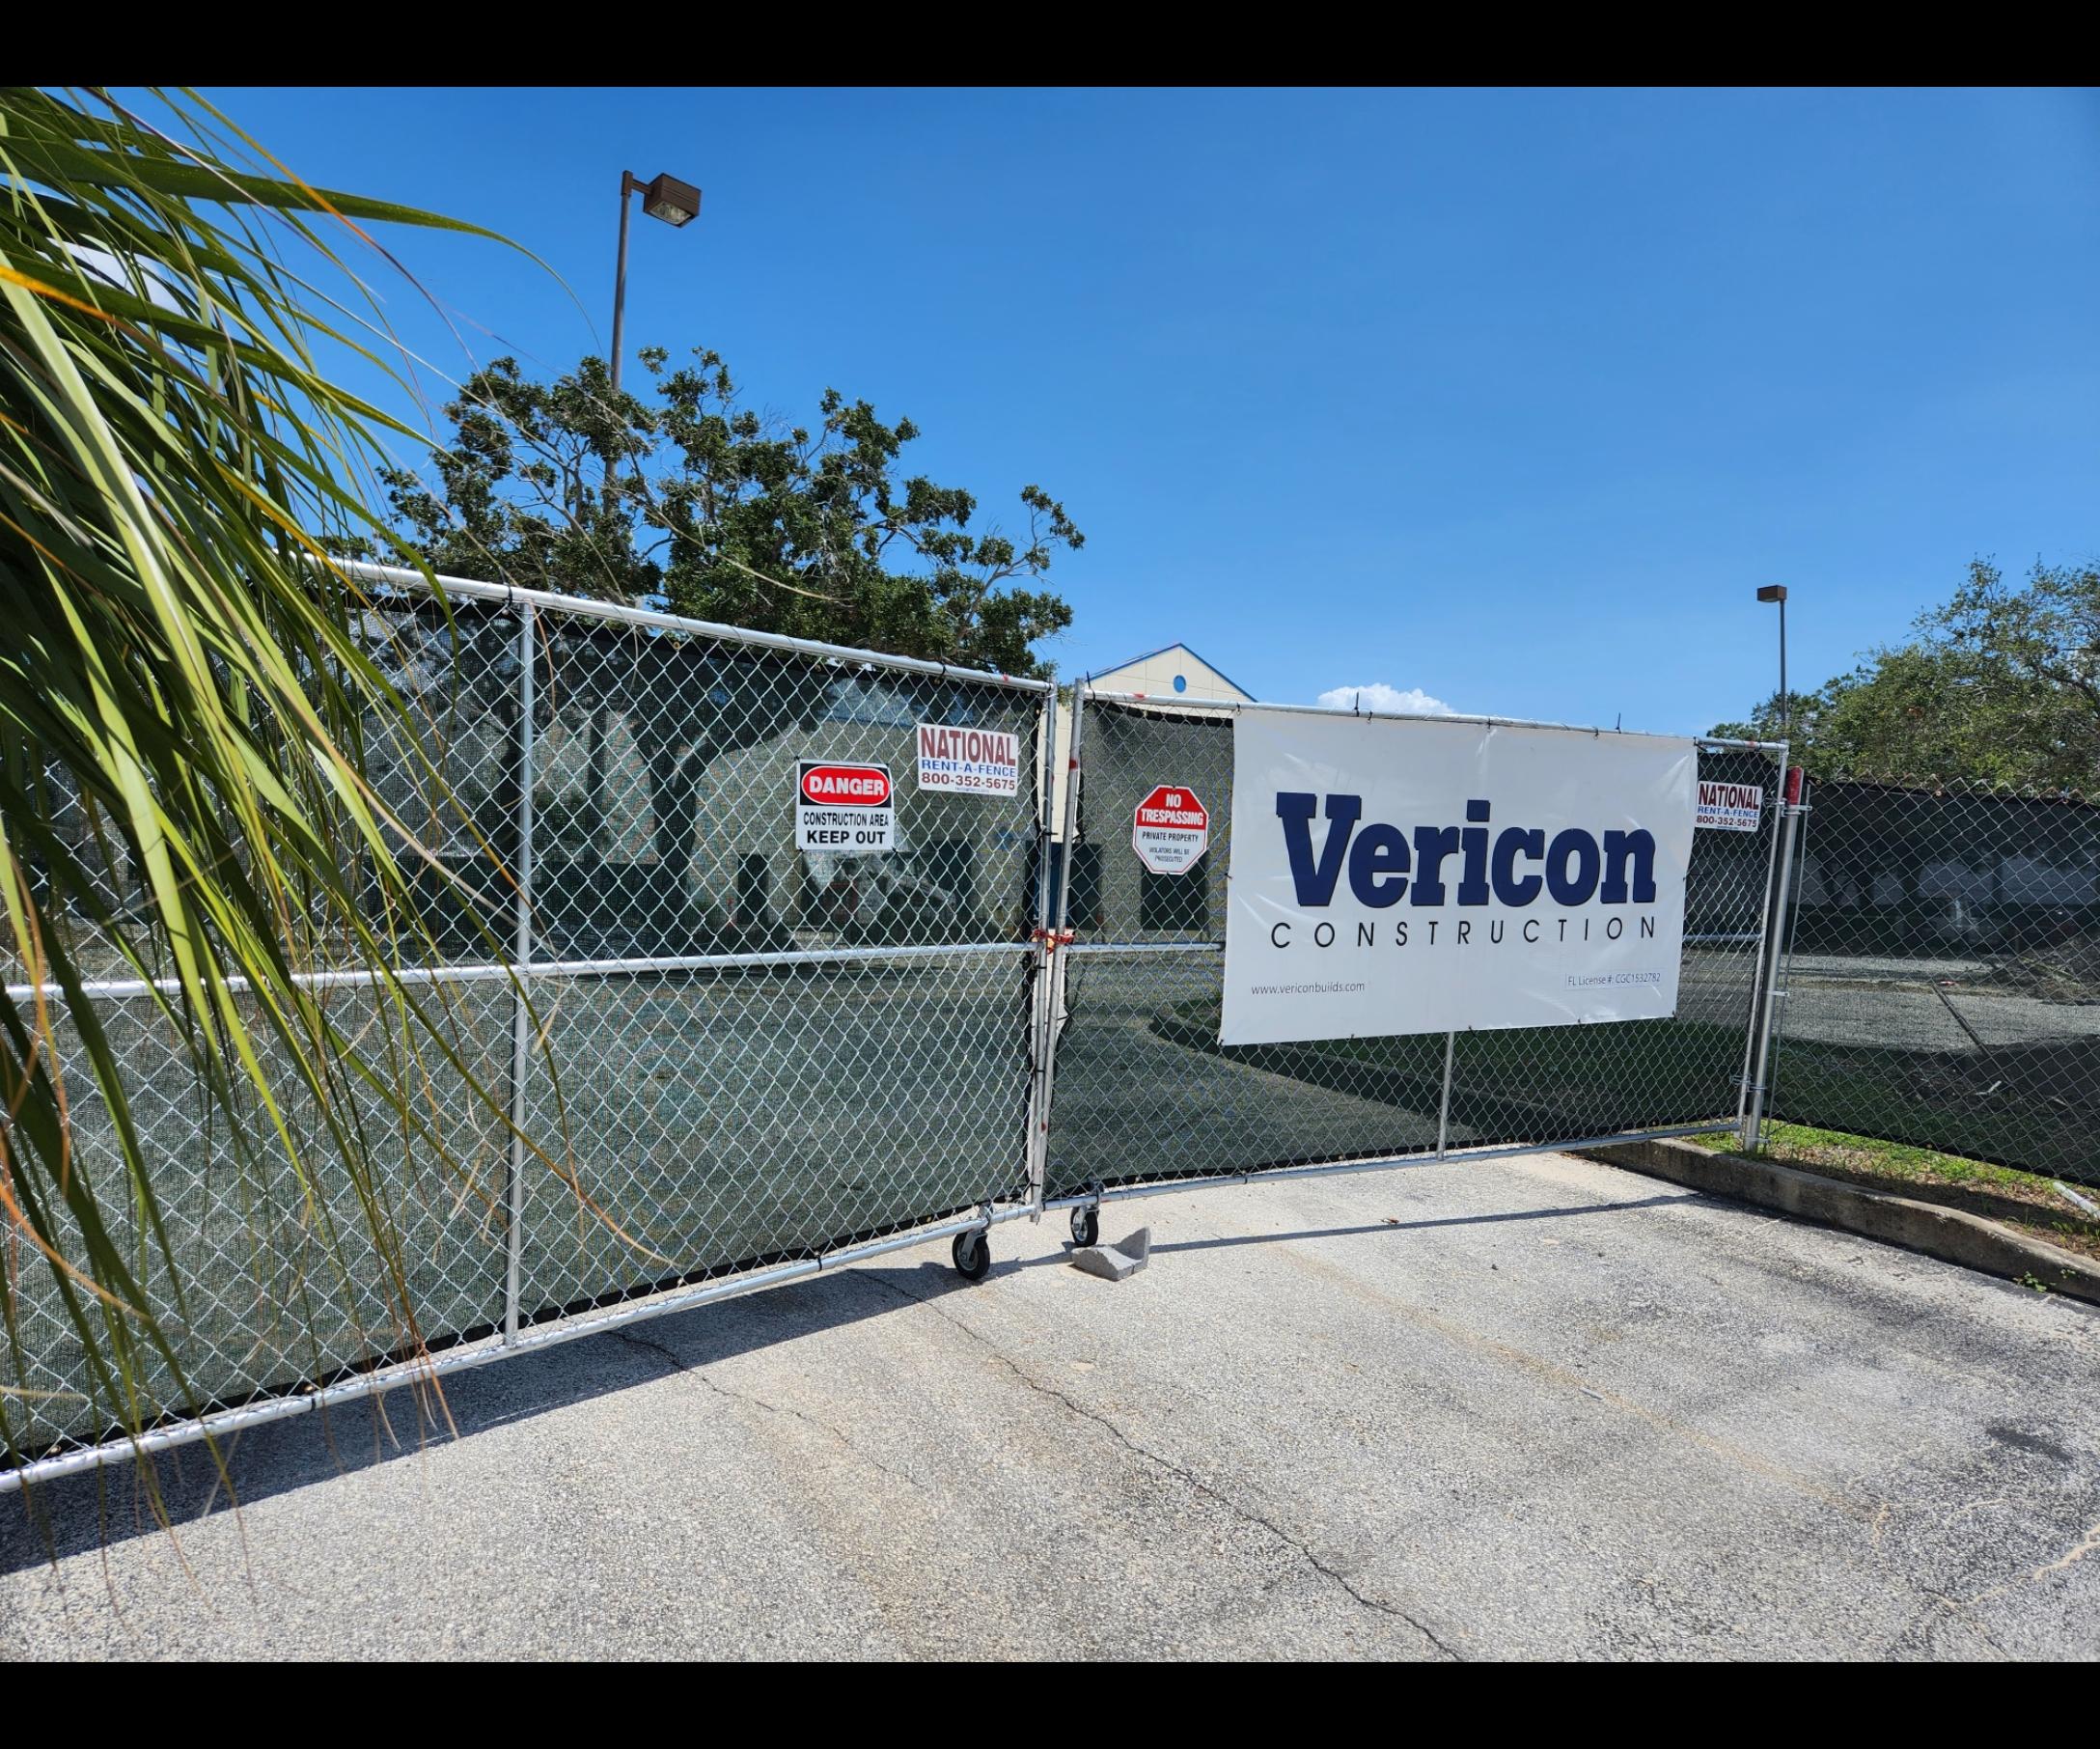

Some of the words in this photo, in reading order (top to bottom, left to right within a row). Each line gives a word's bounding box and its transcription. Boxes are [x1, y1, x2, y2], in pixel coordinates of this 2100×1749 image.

[921, 727, 1016, 766] NATIONAL
[922, 759, 1016, 778] RENT-A-FENCE
[809, 775, 885, 796] DANGER
[922, 772, 1015, 791] 800-352-5675
[1166, 793, 1182, 808] NO
[1699, 784, 1758, 810] NATIONAL
[803, 812, 867, 827] CONSTRUCTION
[869, 814, 889, 827] AREA
[1141, 808, 1203, 825] TRESPASSING
[1698, 806, 1758, 818] RENT-A-FENCE
[1697, 816, 1756, 827] 800-352-5675
[807, 830, 849, 844] KEEP
[855, 831, 886, 845] OUT
[1142, 831, 1167, 841] PRIVATE
[1168, 832, 1199, 843] PROPERTY
[1275, 791, 1657, 909] Vericon
[1270, 916, 1655, 949] CONSTRUCTION
[1251, 981, 1366, 995] www.vericonbuilds.com
[1568, 976, 1577, 986] FL
[1578, 976, 1606, 986] License
